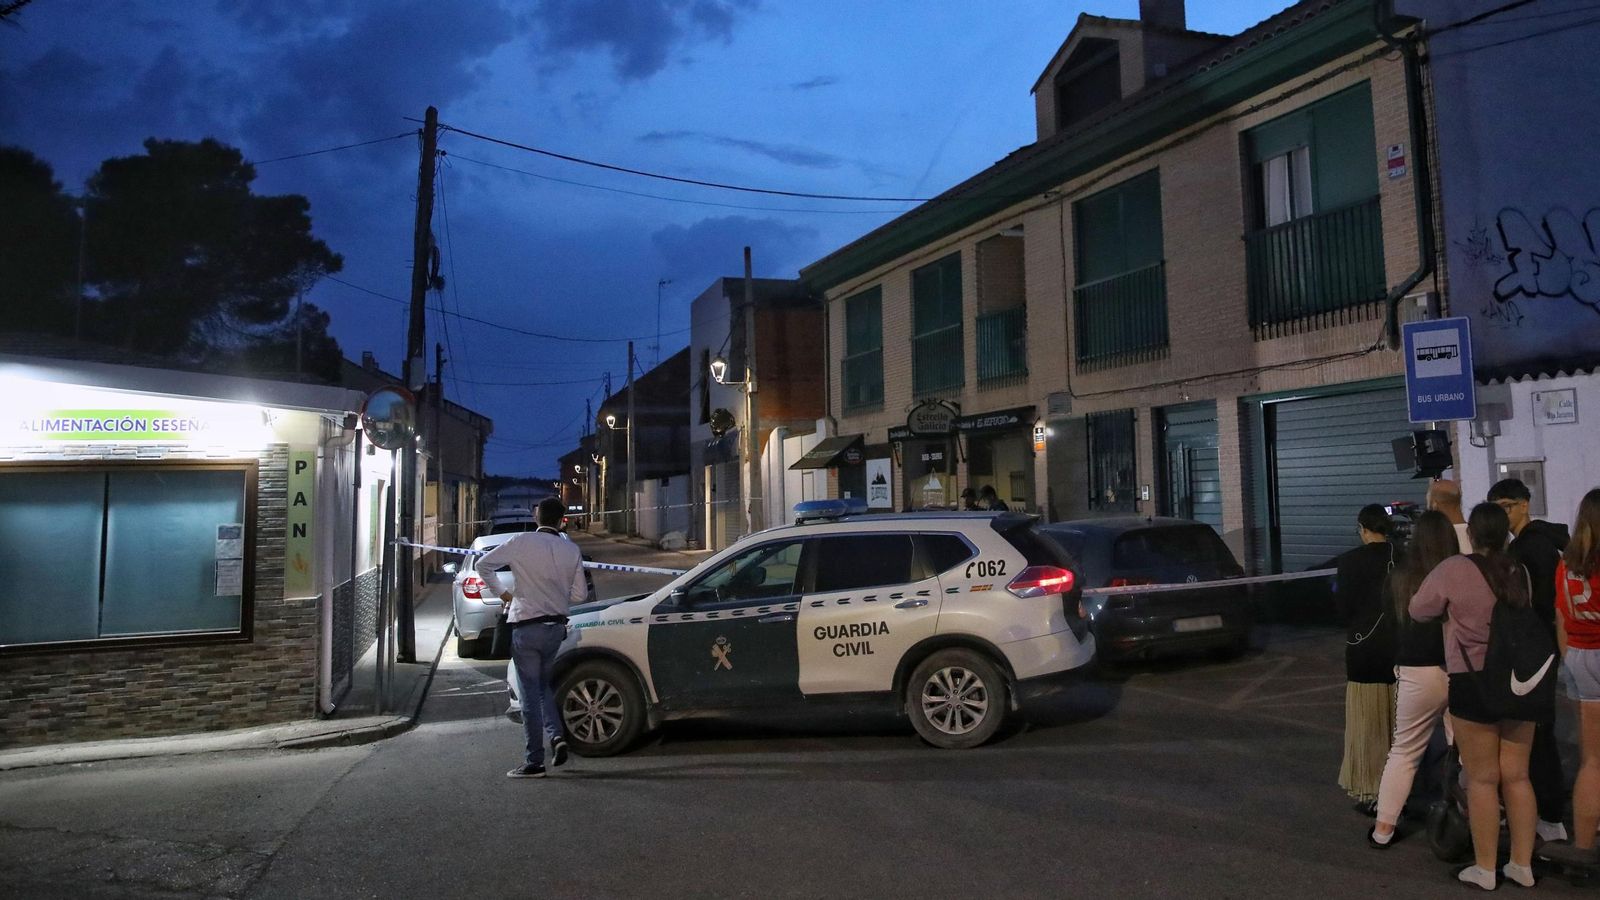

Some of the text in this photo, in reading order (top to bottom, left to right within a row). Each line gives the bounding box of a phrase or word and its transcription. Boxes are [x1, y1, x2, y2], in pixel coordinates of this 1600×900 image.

[1416, 392, 1465, 403] BUS URBANO
[19, 416, 210, 432] ALIMENTACIÓN SESEÑA
[292, 460, 307, 538] PAN
[977, 559, 1006, 577] 062
[574, 620, 606, 629] GUARDIA
[813, 621, 890, 640] GUARDIA
[832, 641, 875, 657] CIVIL
